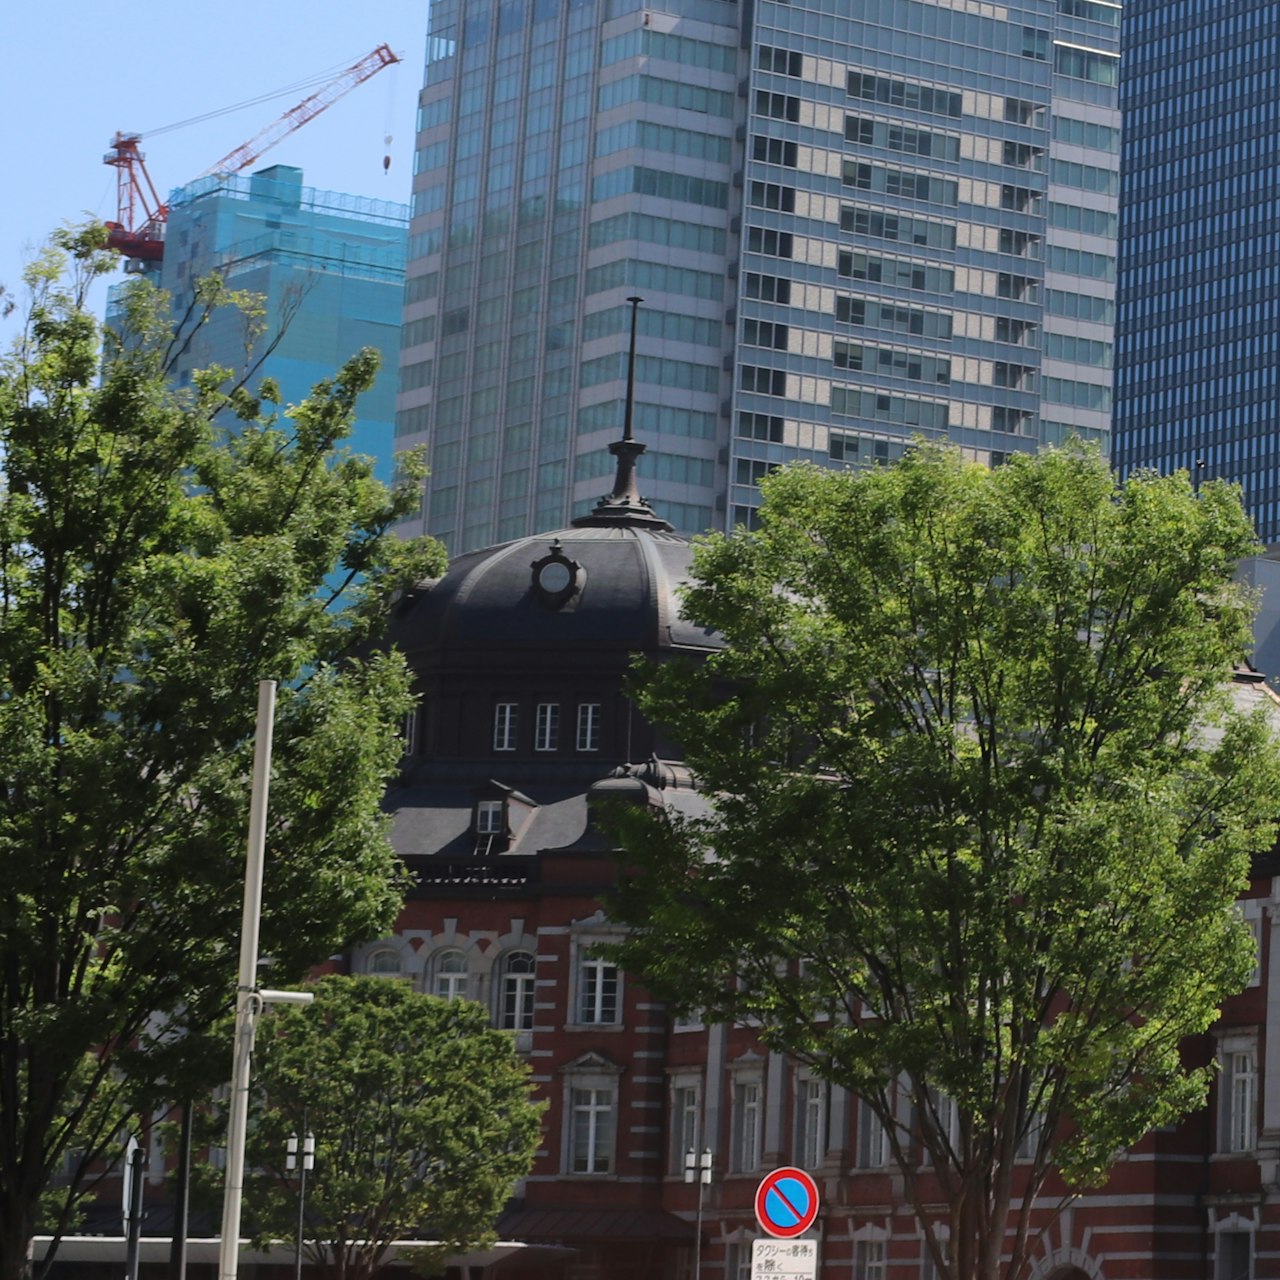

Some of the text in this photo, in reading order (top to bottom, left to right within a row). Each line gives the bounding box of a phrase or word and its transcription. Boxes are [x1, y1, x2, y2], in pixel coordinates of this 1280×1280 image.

[756, 1244, 813, 1257] タクシーの客待ち
